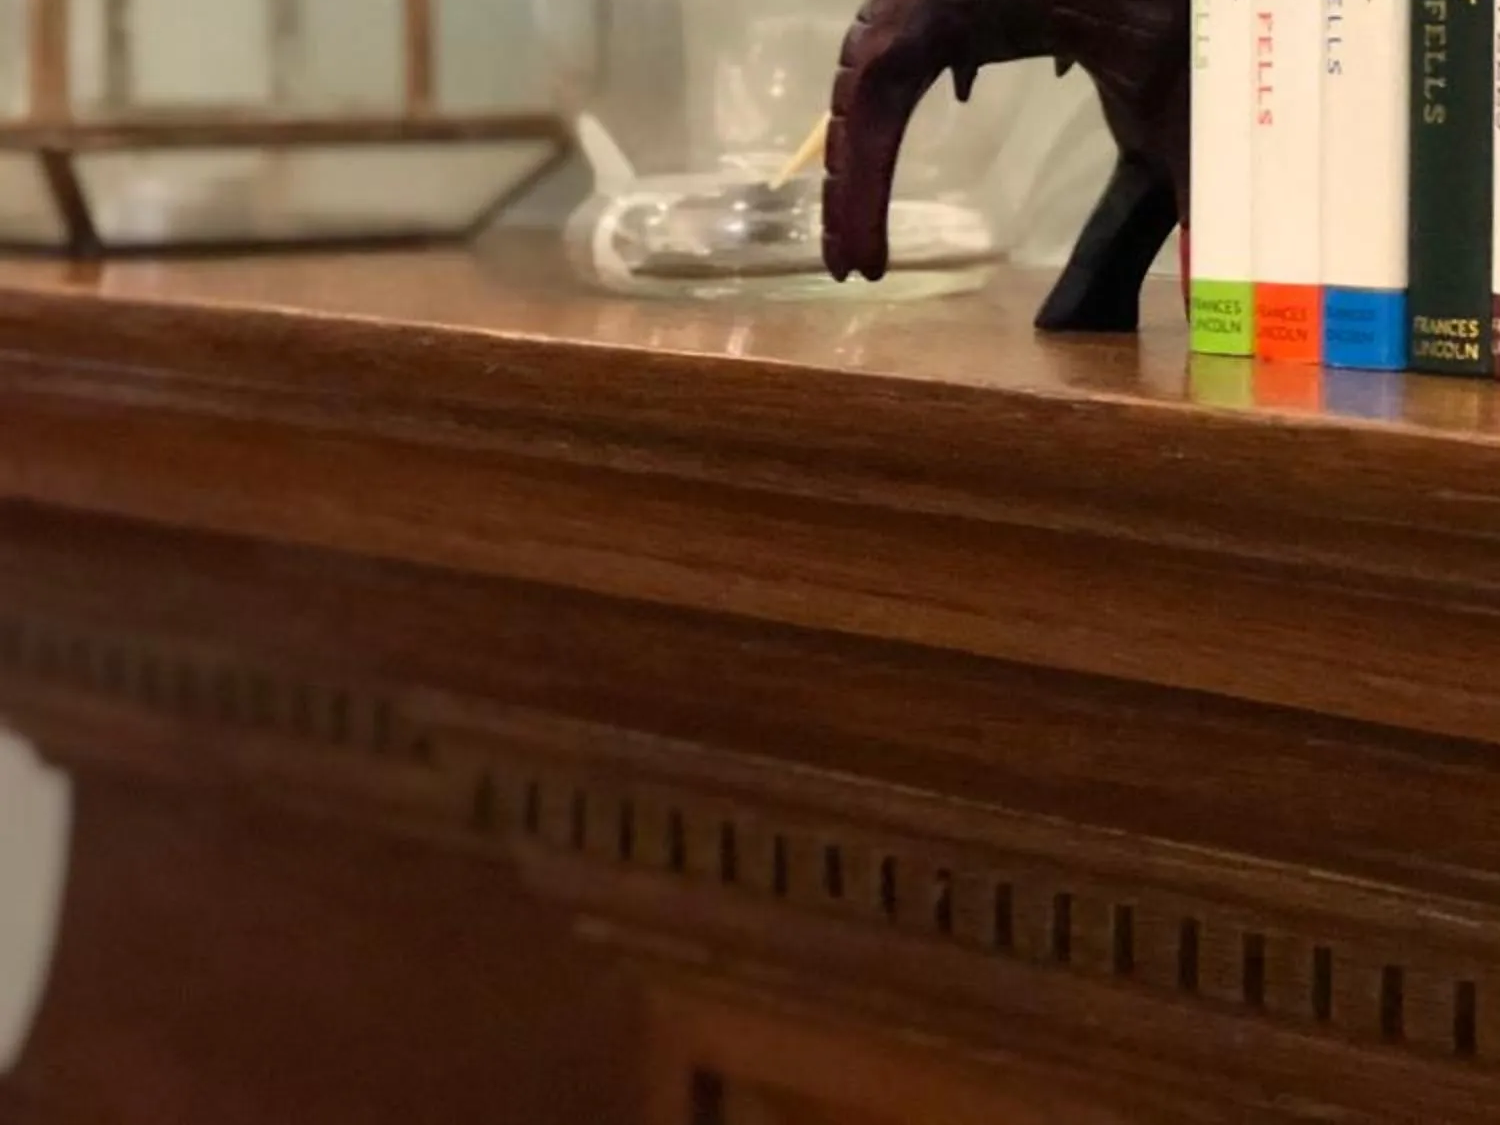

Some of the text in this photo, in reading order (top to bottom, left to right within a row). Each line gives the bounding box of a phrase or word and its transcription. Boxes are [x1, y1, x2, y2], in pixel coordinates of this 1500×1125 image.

[1256, 11, 1274, 126] FELLS
[1413, 314, 1479, 338] FRANCES
[1414, 338, 1479, 361] LINCOLN
